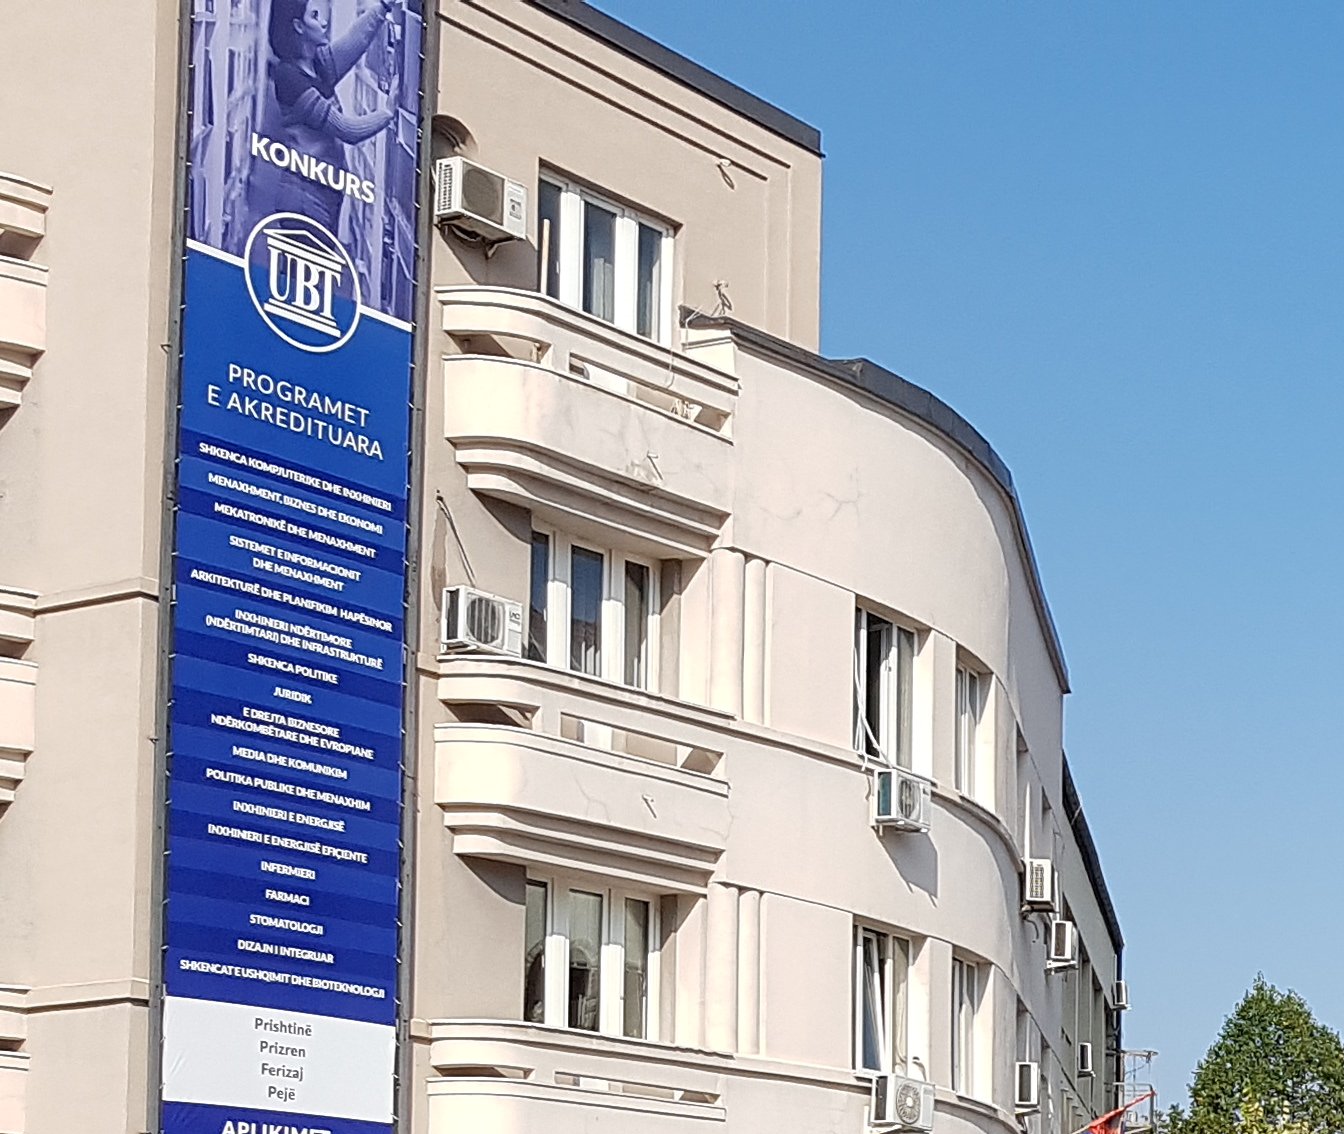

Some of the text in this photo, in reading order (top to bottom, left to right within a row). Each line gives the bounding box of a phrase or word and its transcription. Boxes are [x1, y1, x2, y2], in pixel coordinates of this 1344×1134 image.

[251, 132, 375, 203] KONKURS
[268, 246, 341, 320] UBT
[229, 363, 371, 427] PROGRAMET
[207, 384, 384, 460] E AKREDITUARA
[199, 442, 392, 512] SHKENCA KOMPJUTERIKE DHE INXHINIERI
[208, 472, 383, 534] MENAXHMENT, BIZNES DHE EKONOMI
[214, 502, 377, 559] MEKATRONIKË DHE MENAXHMENT
[229, 535, 276, 557] SISTEMET
[283, 549, 361, 581] INFORMACIONIT
[253, 557, 344, 591] DHE MENAXHMENT
[191, 569, 393, 632] ARKITEKTURË DHE PLANIFIKIM HAPËSINOR
[205, 614, 383, 669] (NDËRTIMTARI) DHE INFRASTRUKTURË
[235, 609, 353, 649] INXHINIERI NDËRTIMORE
[248, 653, 338, 684] SHKENCA POLITIKE
[273, 686, 312, 704] JURIDIK
[211, 714, 374, 759] NDËRKOMBËTARE DHE EVROPIANE
[243, 707, 339, 738] E DREJTA BIZNESORE
[232, 746, 347, 779] MEDIA DHE KOMUNIKIM
[206, 768, 370, 811] POLITIKA PUBLIKE DHE MENAXHIM
[233, 801, 345, 832] INXHINIERI E ENERGJISË
[208, 823, 368, 864] INXHINIERI E ENERGJISË EFIÇIENTE
[261, 861, 315, 880] INFERMIERI
[265, 889, 309, 906] FARMACI
[249, 914, 323, 935] STOMATOLOGJI
[237, 939, 274, 954] DIZAJN
[280, 945, 334, 964] INTEGRUAR
[180, 959, 235, 976] SHKENCAT
[242, 967, 291, 984] USHQIMIT
[291, 975, 312, 987] DHE
[312, 977, 385, 999] BIOTEKNOLOGJI
[254, 1018, 312, 1037] Prishtinë
[260, 1041, 306, 1058] Prizren
[261, 1062, 304, 1082] Ferizaj
[268, 1085, 296, 1102] Pejë
